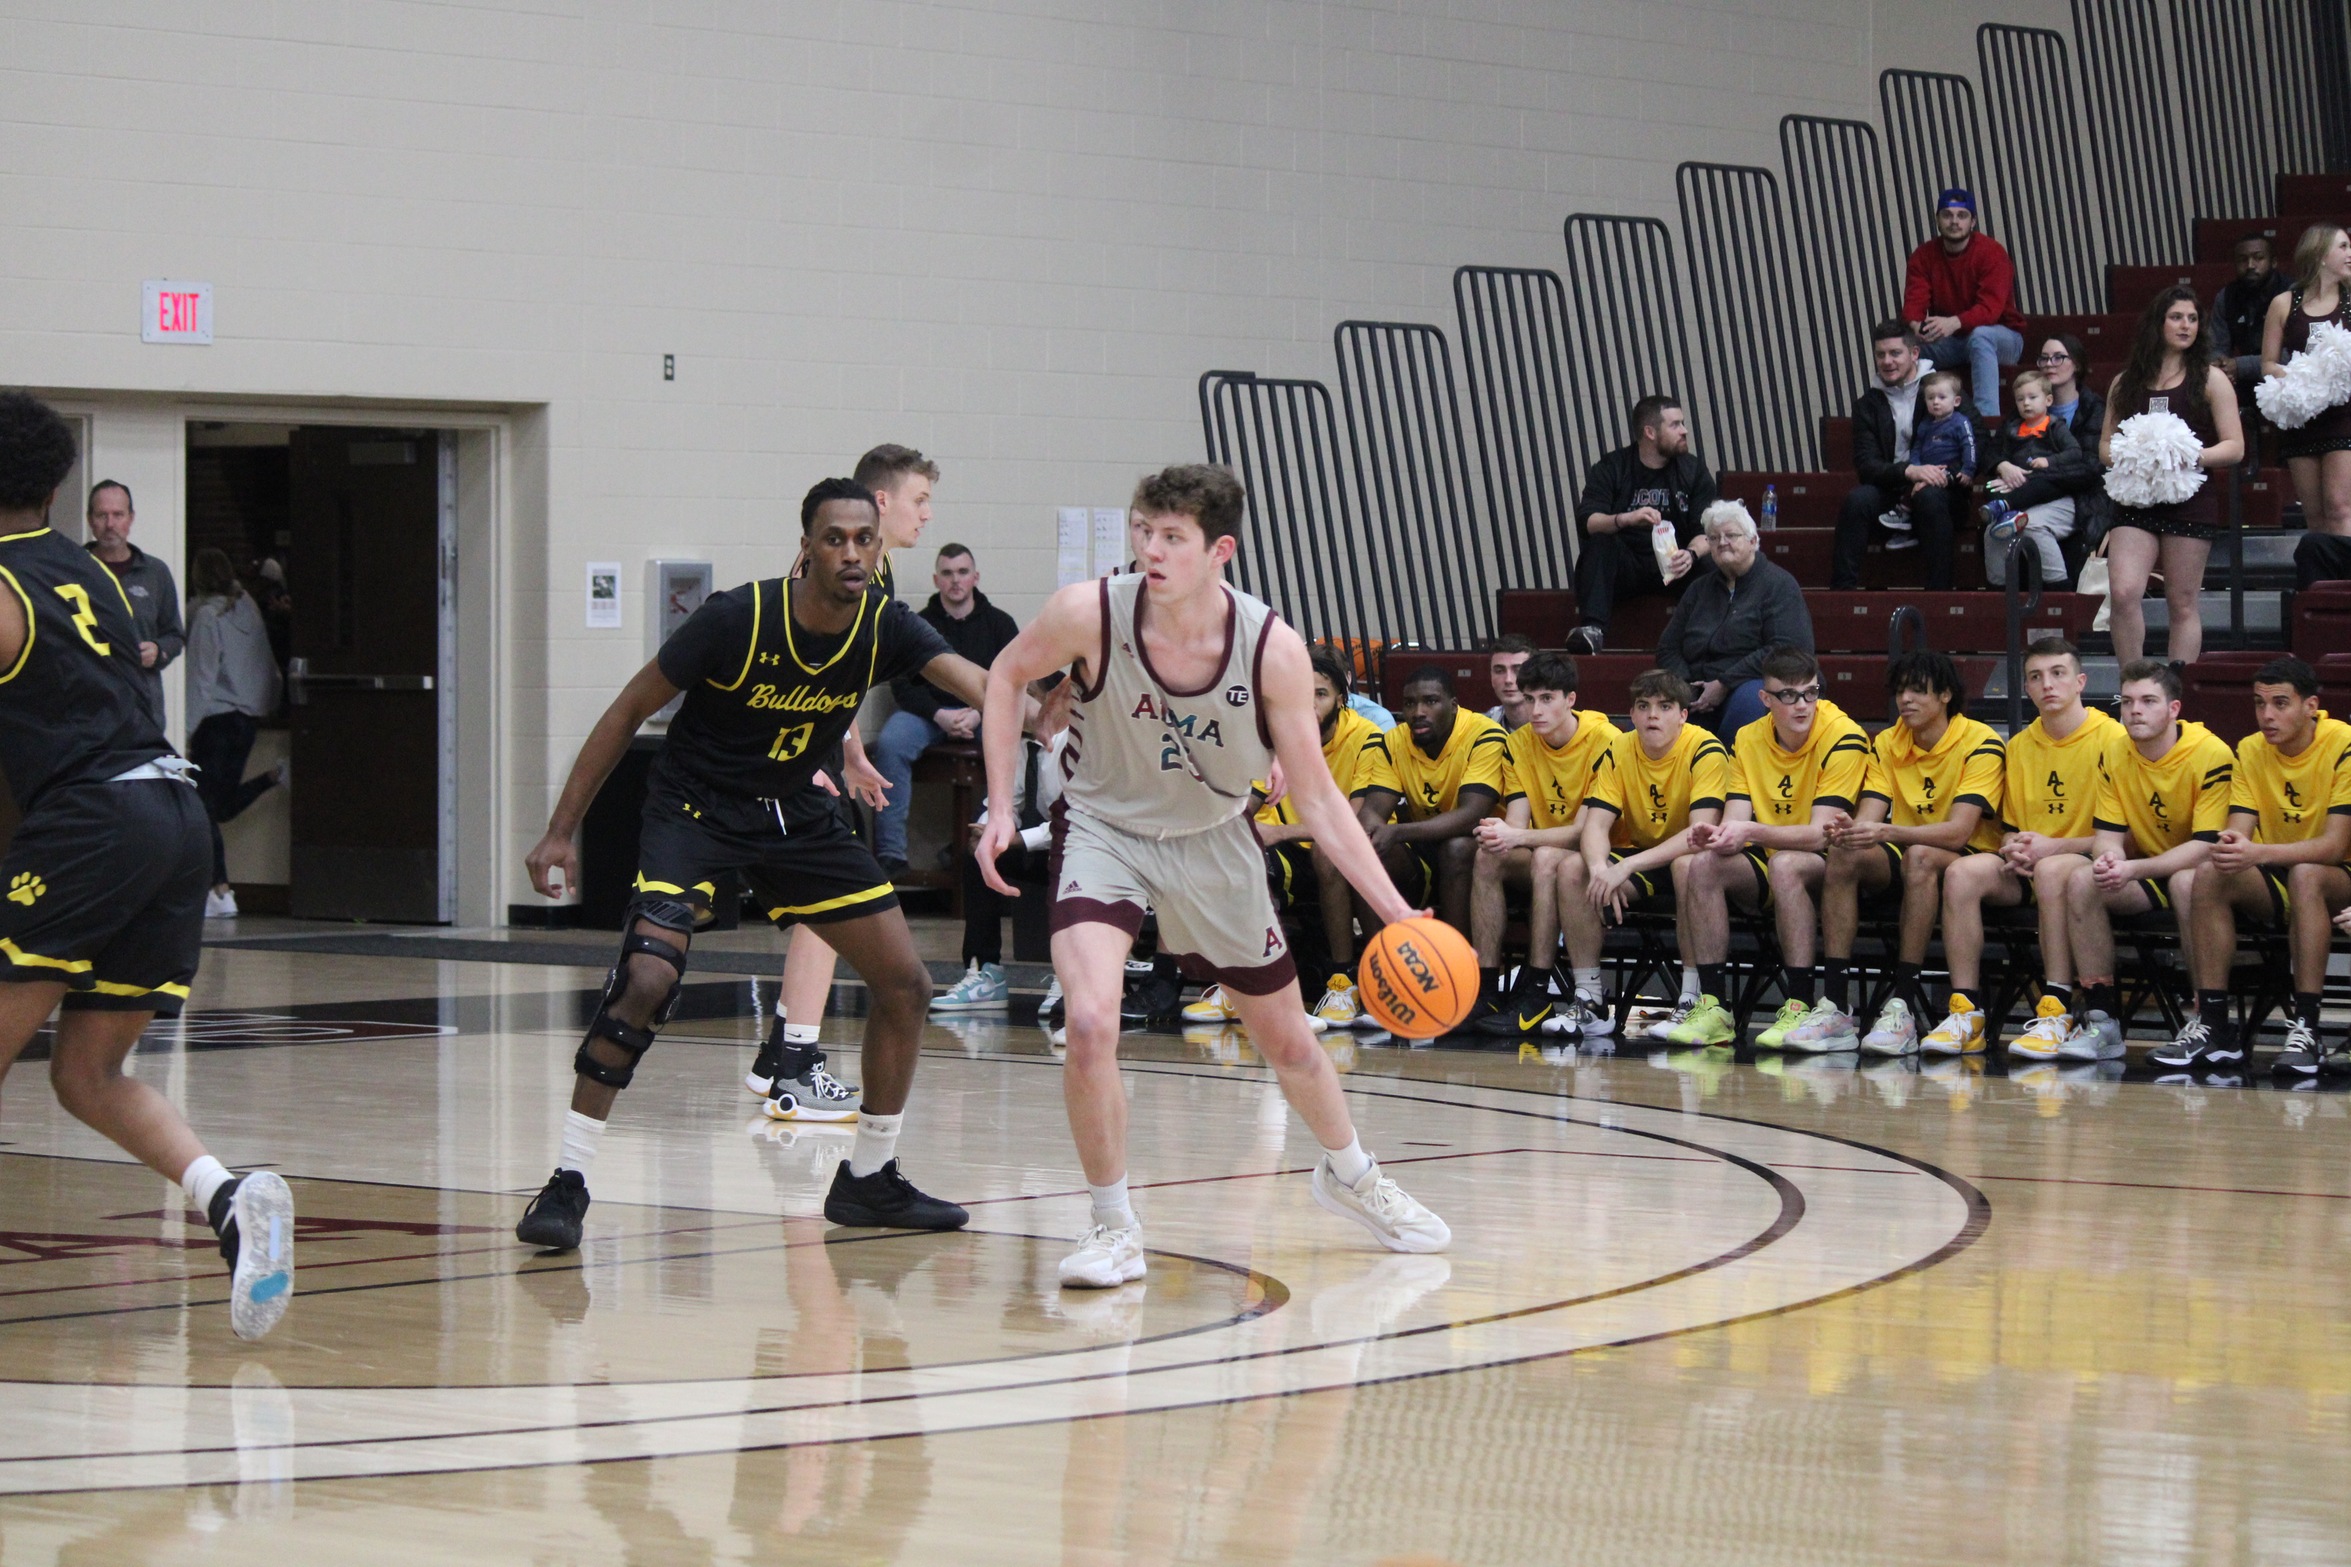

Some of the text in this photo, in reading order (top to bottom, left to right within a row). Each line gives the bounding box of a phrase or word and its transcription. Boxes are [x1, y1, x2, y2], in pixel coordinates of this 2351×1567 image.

[159, 292, 200, 333] EXIT
[53, 583, 111, 657] 2
[746, 683, 858, 714] Bulldogs
[1228, 689, 1248, 703] TE
[767, 721, 815, 762] 13
[1422, 782, 1440, 805] AC
[1778, 774, 1793, 798] AC
[2046, 770, 2065, 797] AC
[2283, 781, 2302, 808] AC
[2149, 791, 2168, 819] AC
[1262, 926, 1283, 958] A
[1397, 941, 1439, 994] NCAA
